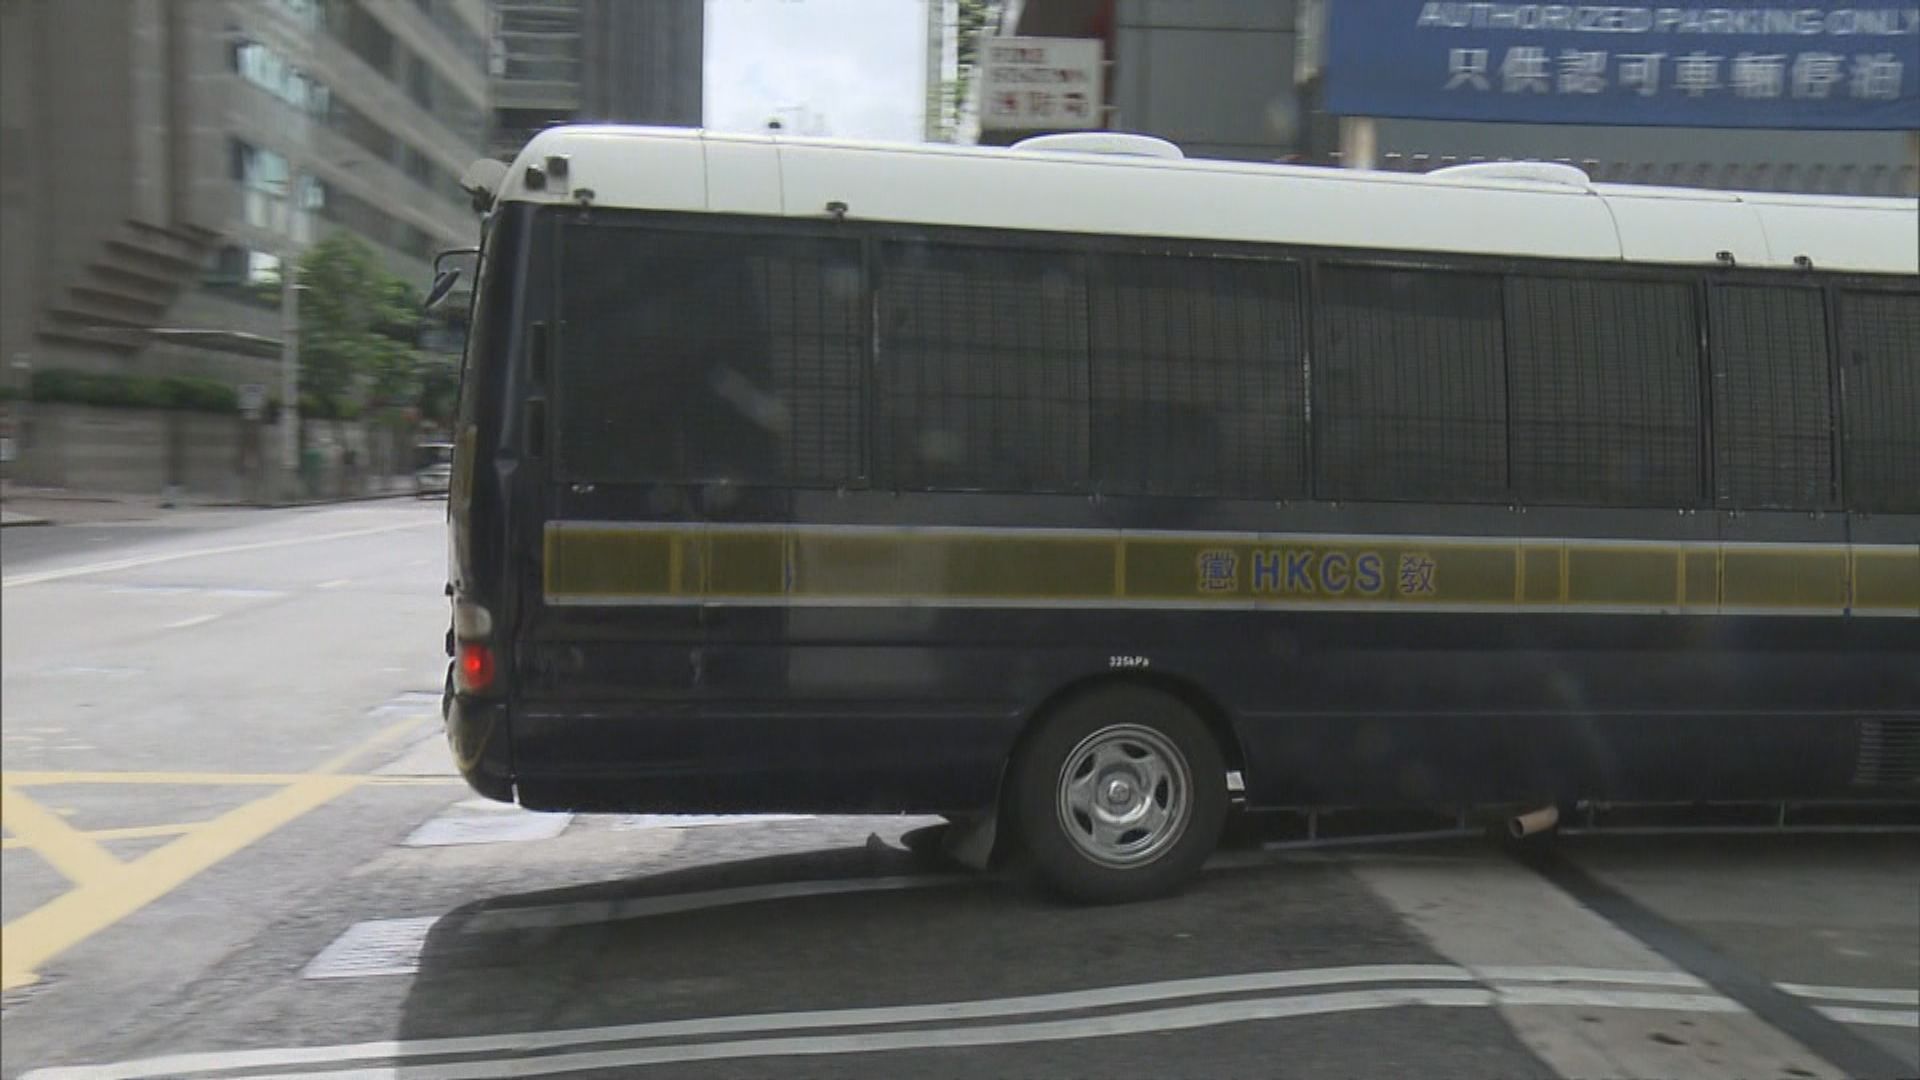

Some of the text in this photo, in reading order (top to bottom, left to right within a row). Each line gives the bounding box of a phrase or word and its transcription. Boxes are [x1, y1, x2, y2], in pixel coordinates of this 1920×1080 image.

[1417, 2, 1650, 32] AUTHORIZED
[1655, 7, 1824, 35] PARKING
[1253, 552, 1382, 592] HKCS
